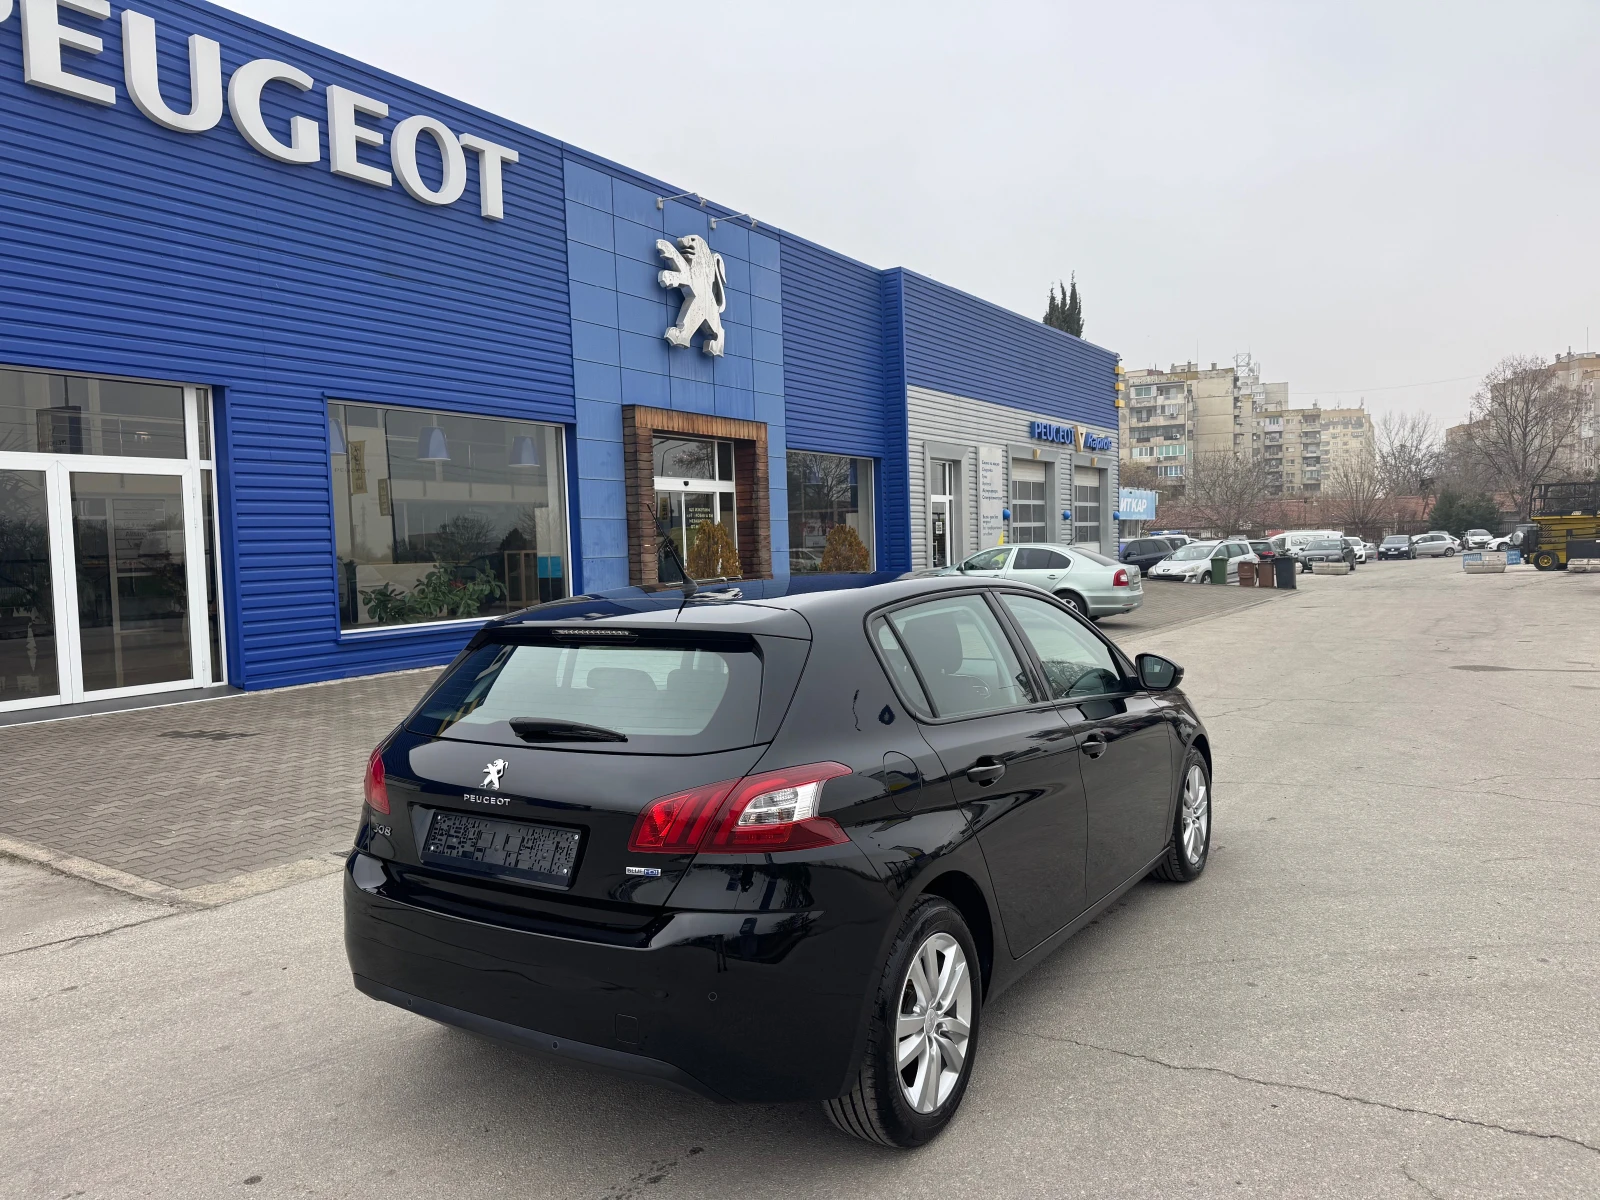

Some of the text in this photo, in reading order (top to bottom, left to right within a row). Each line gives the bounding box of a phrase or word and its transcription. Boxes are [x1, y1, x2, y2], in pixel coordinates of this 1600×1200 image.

[0, 0, 519, 220] EUGEOT
[1033, 421, 1075, 444] PEUGEOT
[463, 793, 511, 806] PEUGEOT
[372, 823, 392, 836] 308
